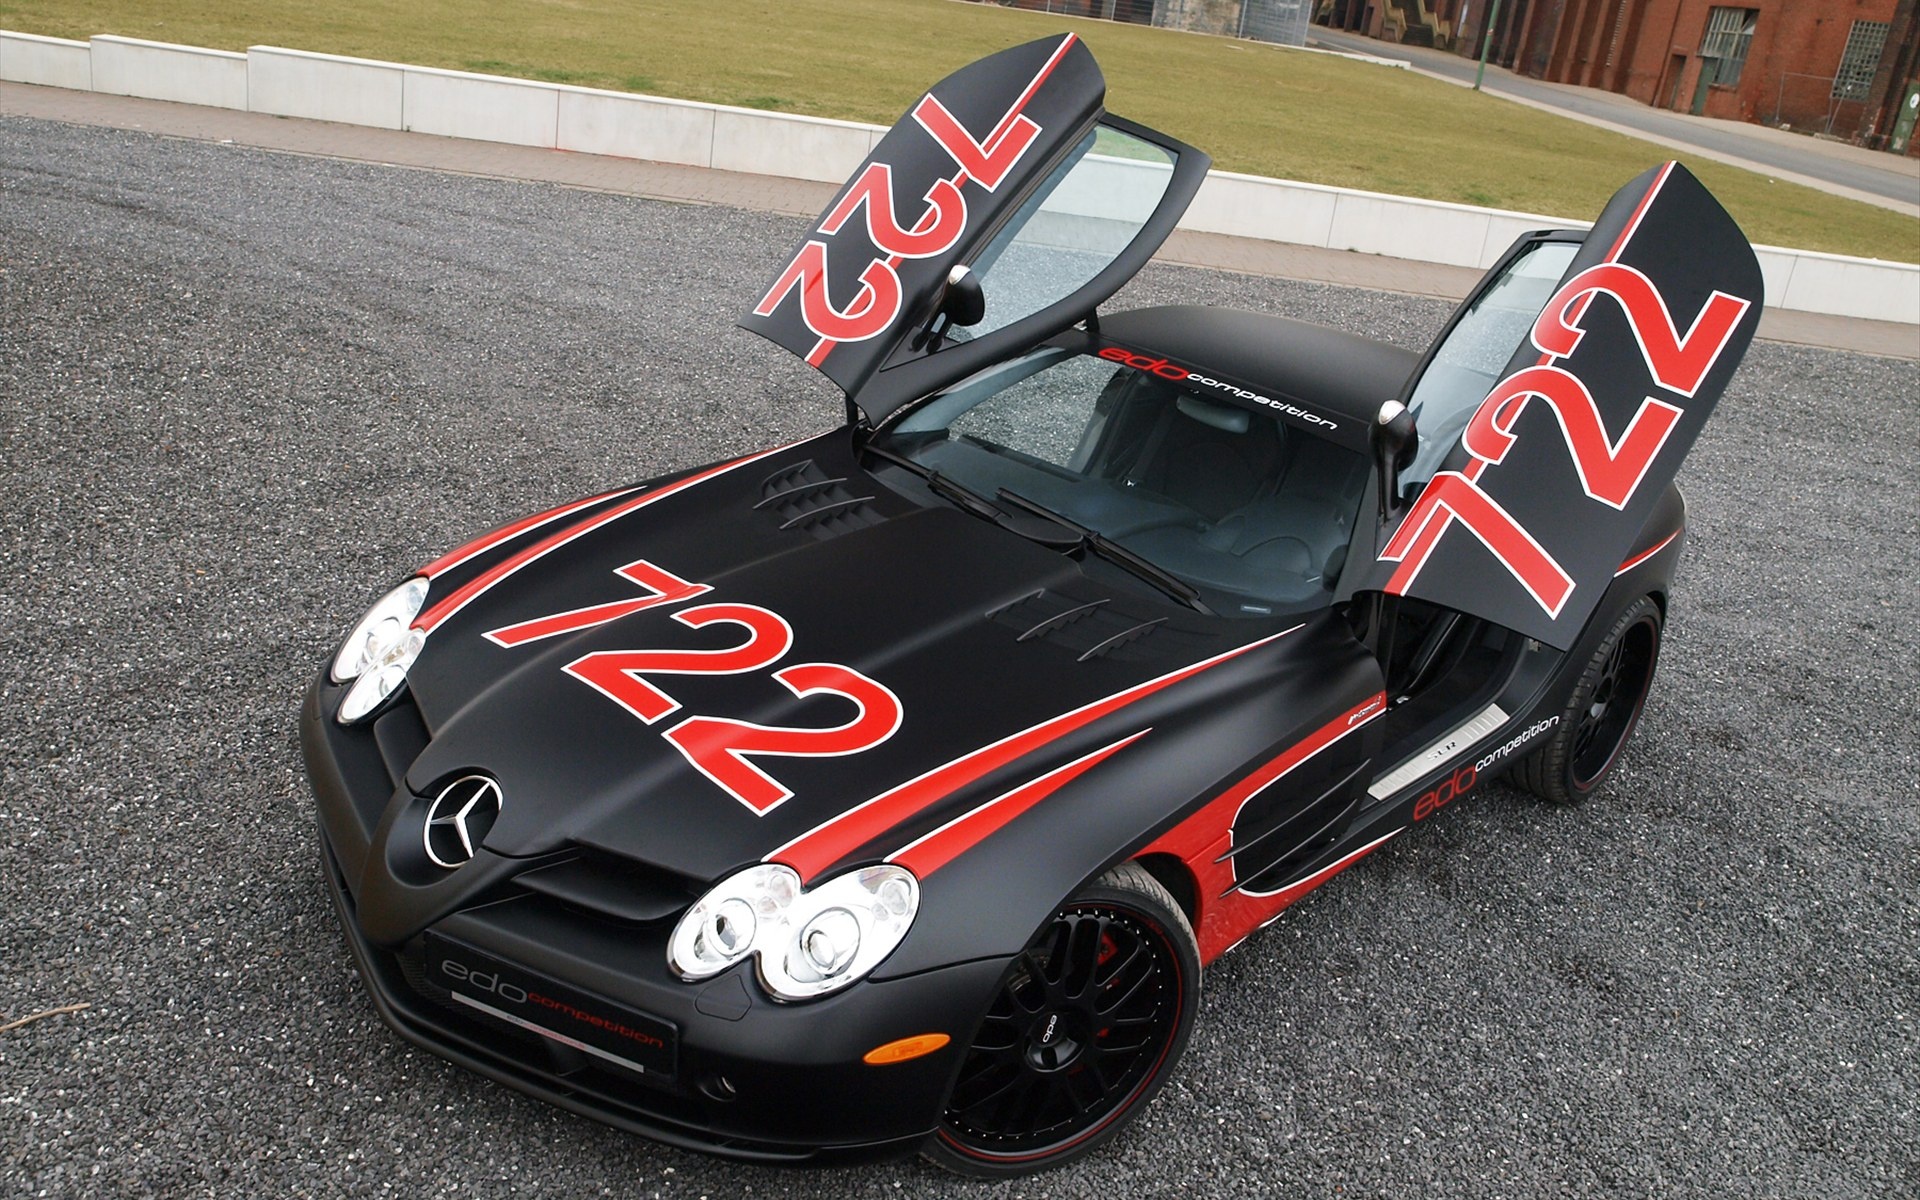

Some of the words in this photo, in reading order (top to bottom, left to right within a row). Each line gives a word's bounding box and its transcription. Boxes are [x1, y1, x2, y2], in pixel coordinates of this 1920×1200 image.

[752, 92, 1043, 343] 722
[1377, 263, 1751, 620] 722
[481, 559, 904, 818] 722
[1427, 740, 1457, 761] SLR
[1042, 1014, 1058, 1043] edo
